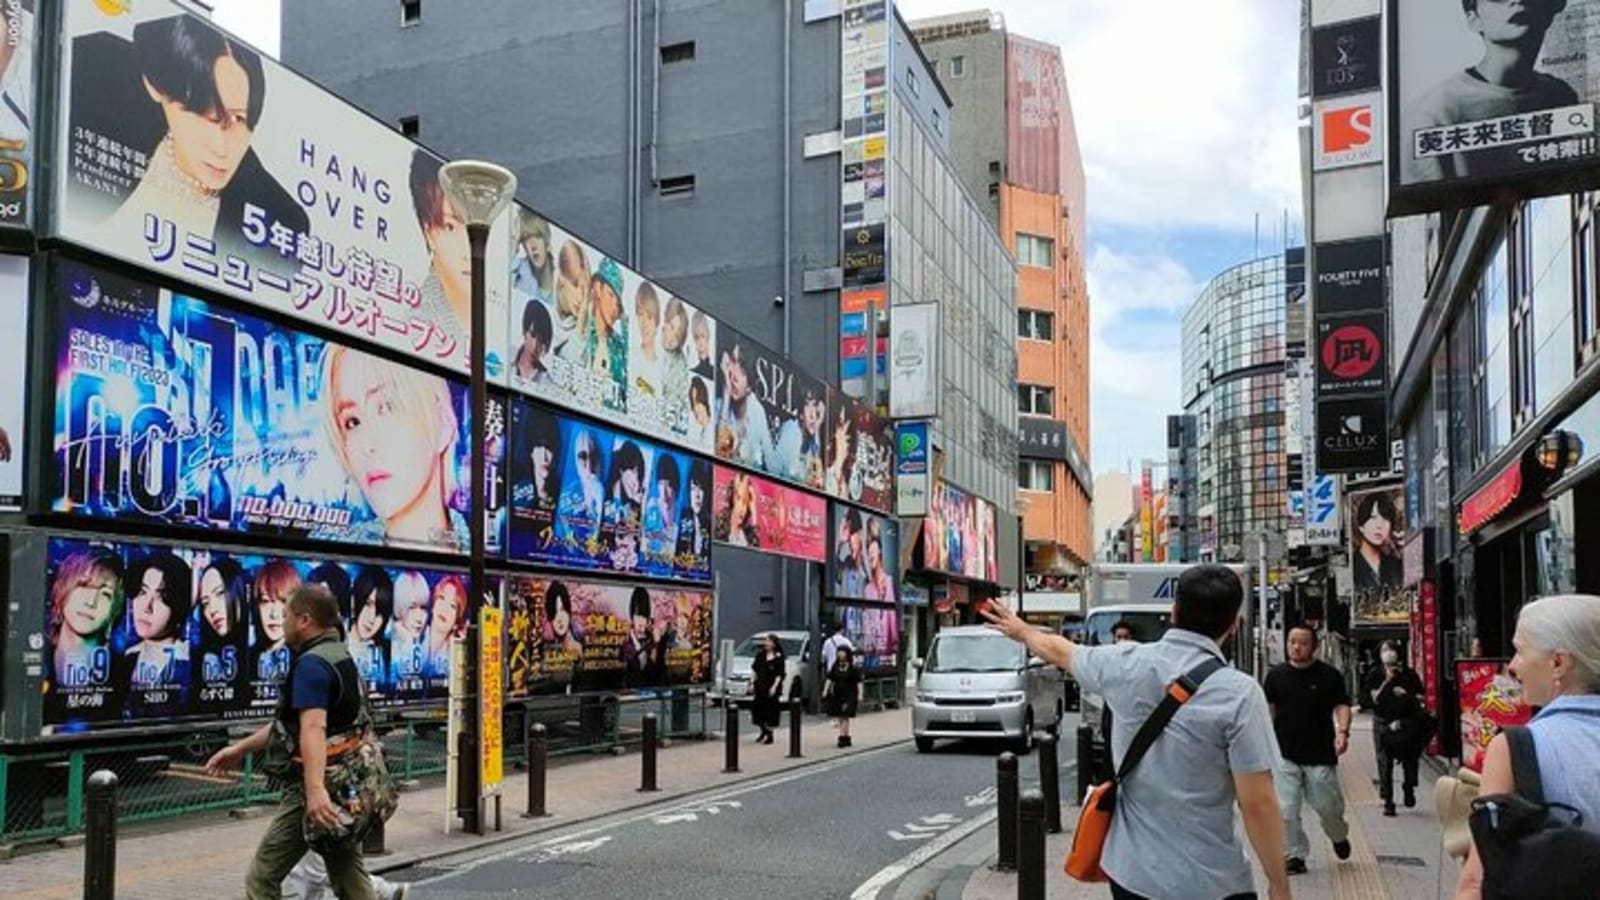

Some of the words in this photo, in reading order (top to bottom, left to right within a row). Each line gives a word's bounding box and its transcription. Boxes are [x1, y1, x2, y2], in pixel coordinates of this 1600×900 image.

[300, 138, 392, 206] HANG
[296, 180, 389, 243] OVER
[241, 203, 423, 308] 5年越し待望の
[1323, 434, 1379, 449] CELUX
